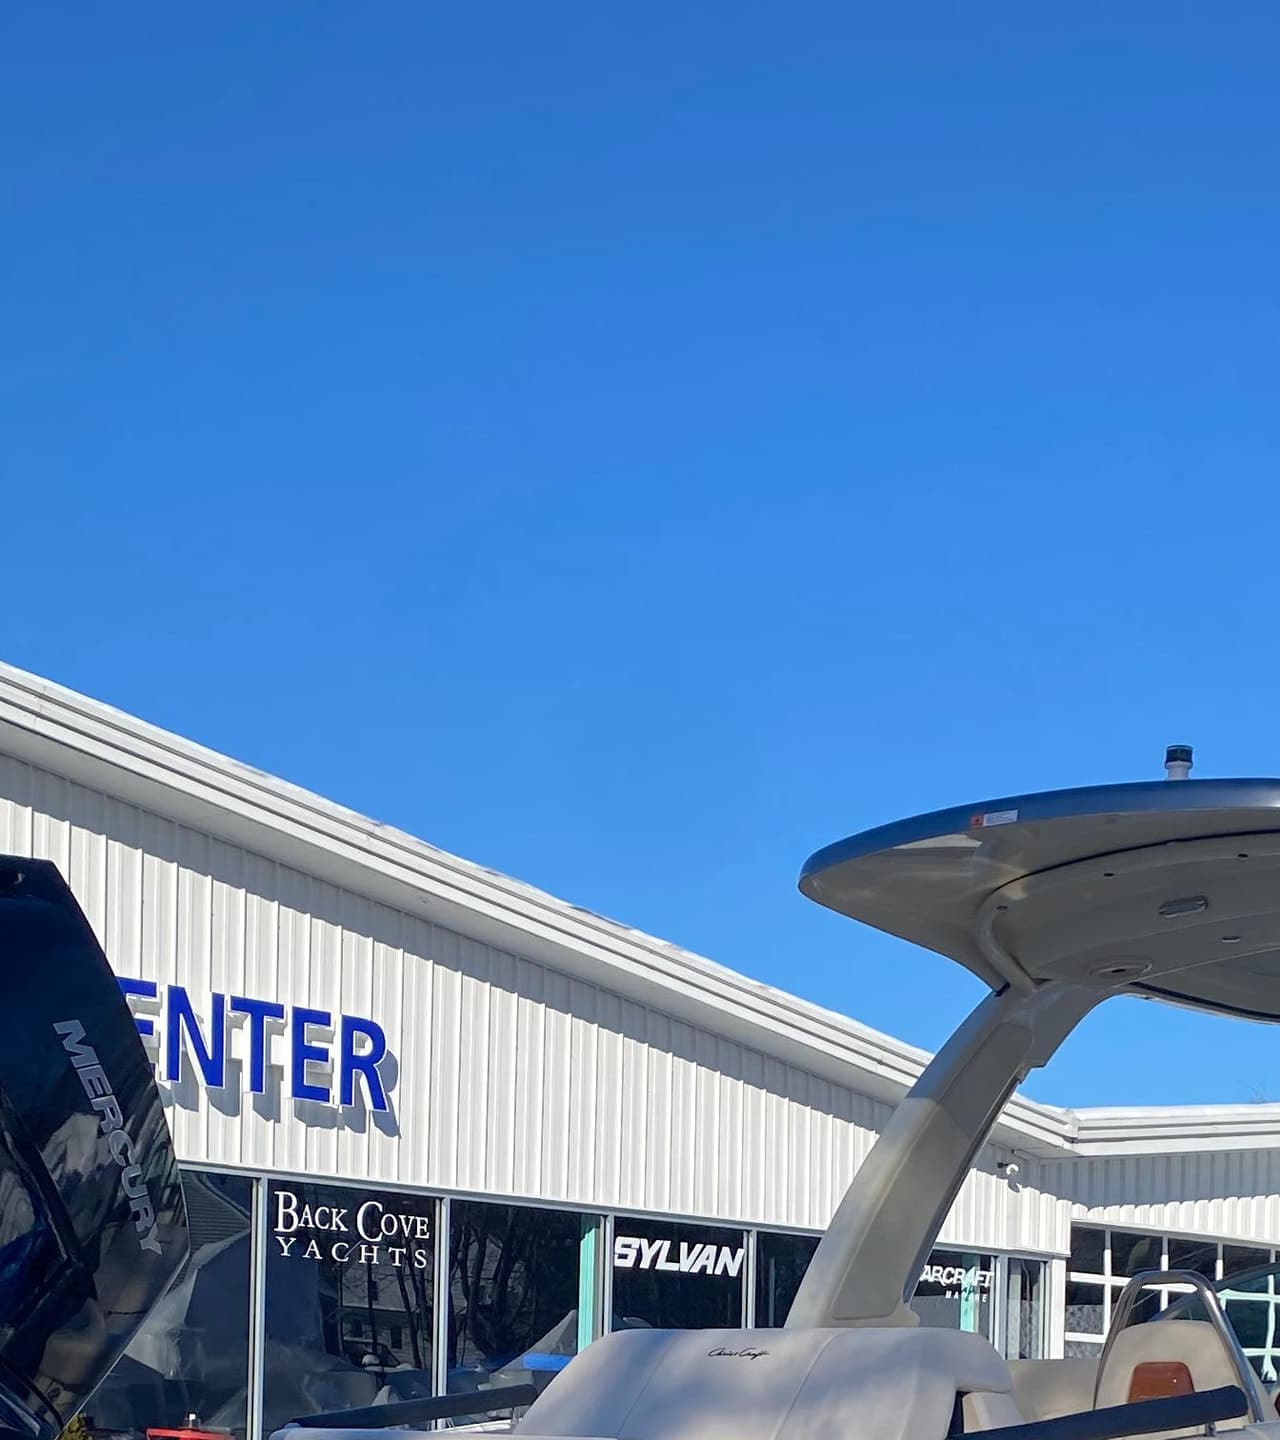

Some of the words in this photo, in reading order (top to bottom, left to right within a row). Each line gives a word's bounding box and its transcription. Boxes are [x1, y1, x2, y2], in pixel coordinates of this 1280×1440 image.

[114, 976, 389, 1112] ENTER
[52, 1019, 163, 1255] MERCURY
[274, 1191, 349, 1233] BACK
[356, 1201, 430, 1242] COVE
[275, 1236, 428, 1268] YACHTS
[614, 1236, 745, 1277] SYLVAN
[919, 1265, 995, 1288] ARCRAFT
